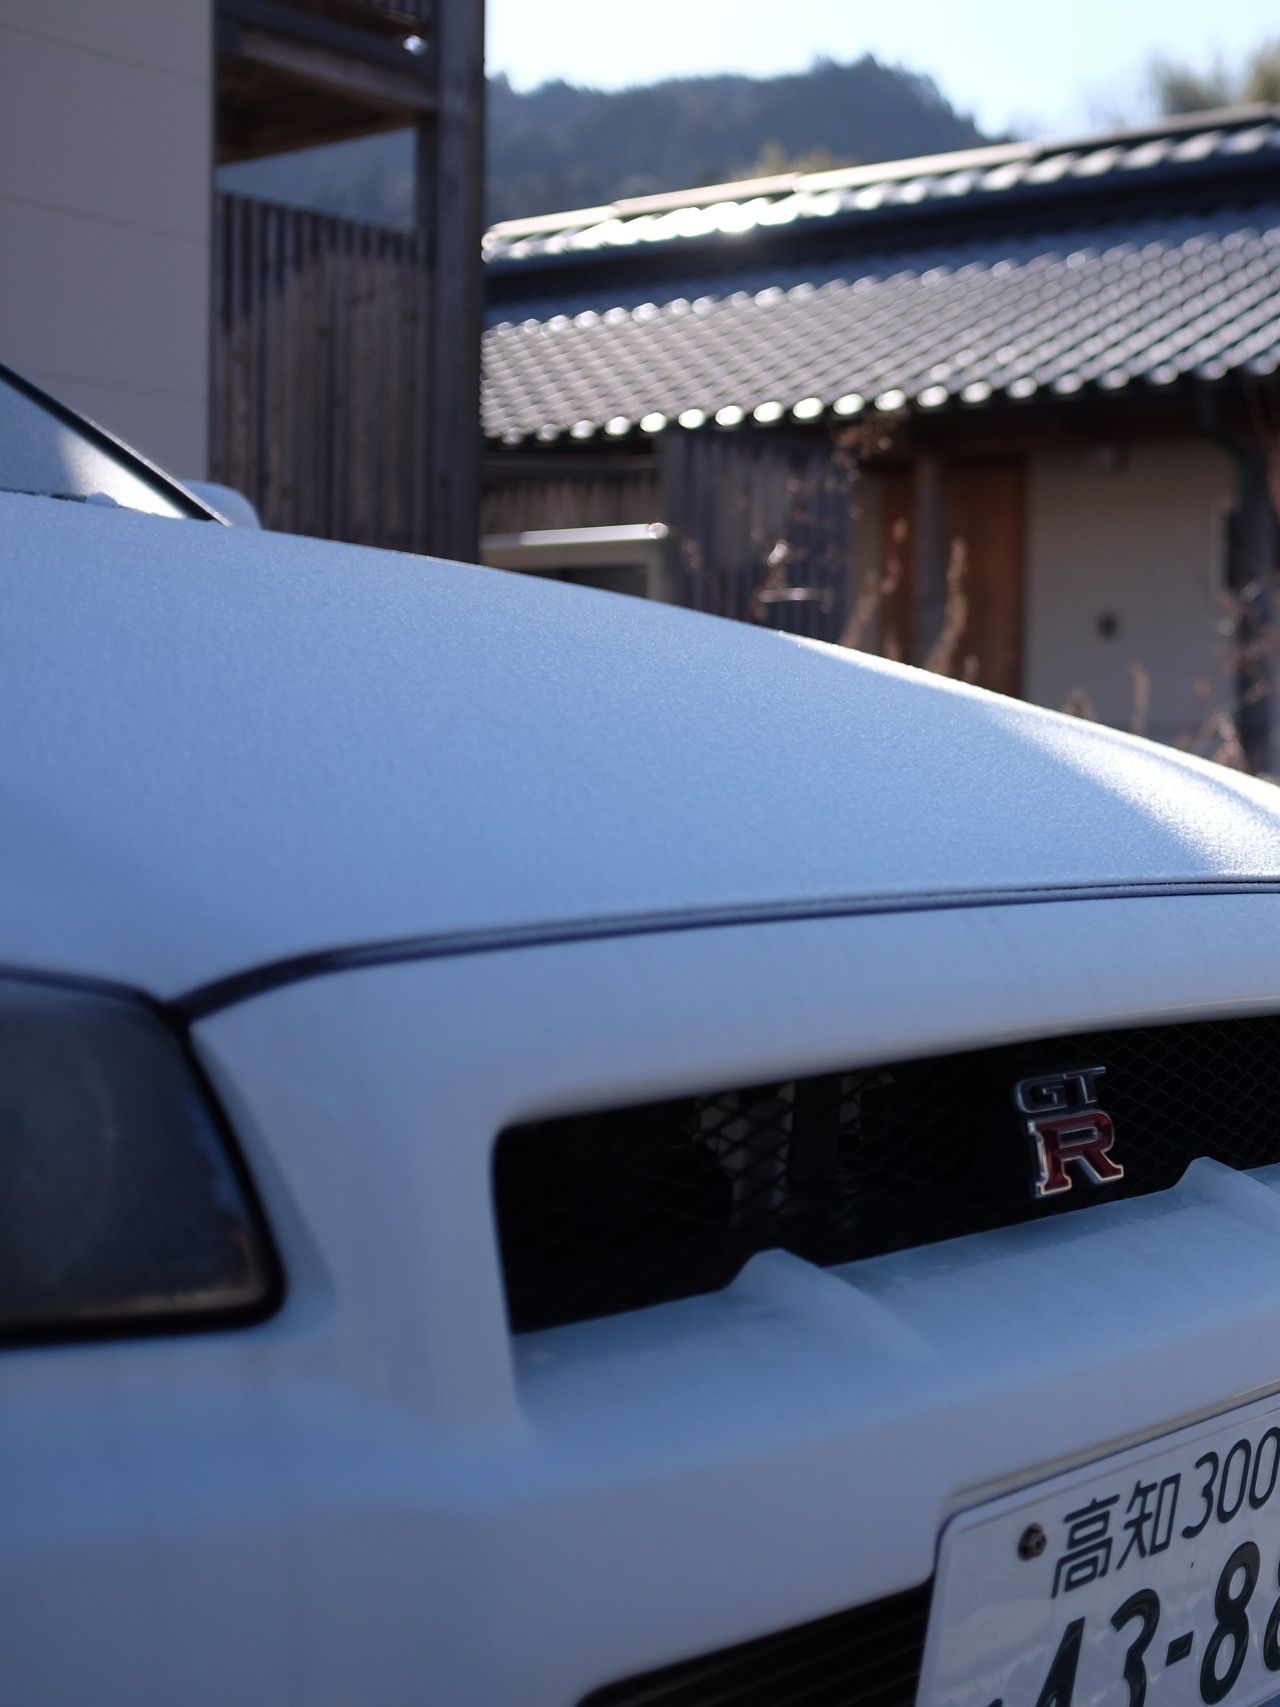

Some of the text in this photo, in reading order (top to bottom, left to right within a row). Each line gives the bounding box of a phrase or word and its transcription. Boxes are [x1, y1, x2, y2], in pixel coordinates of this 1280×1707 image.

[1015, 1066, 1106, 1113] GT
[1027, 1110, 1124, 1196] R
[1051, 1472, 1182, 1599] 高知
